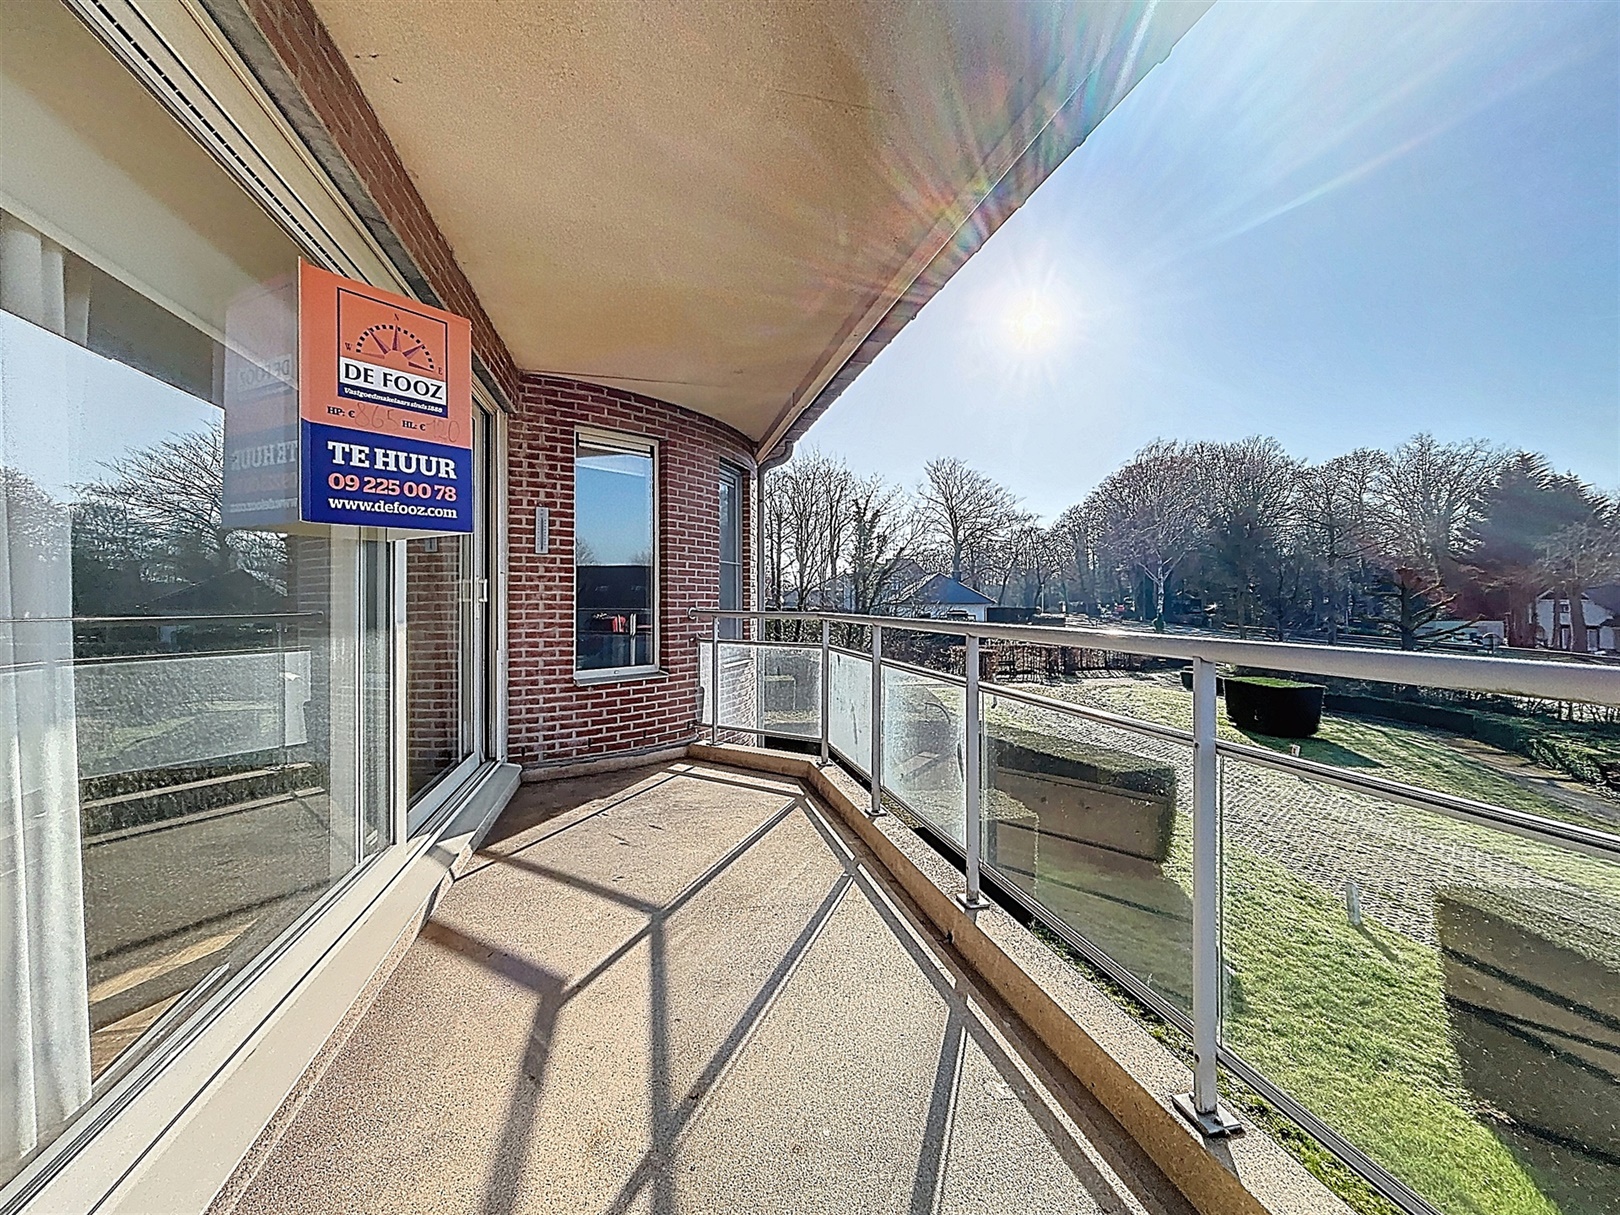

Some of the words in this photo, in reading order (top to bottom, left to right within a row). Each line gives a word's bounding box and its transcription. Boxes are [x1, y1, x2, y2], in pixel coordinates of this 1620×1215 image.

[344, 342, 353, 351] W
[344, 362, 375, 385] DE
[382, 371, 444, 400] FOOZ
[438, 366, 443, 376] E
[343, 387, 411, 407] Vastgoedmakelaars
[410, 401, 428, 411] sinds
[327, 405, 346, 417] HP:
[348, 409, 356, 419] €
[355, 402, 400, 431] 865
[401, 419, 418, 430] HL:
[419, 423, 427, 431] €
[327, 440, 370, 469] TE
[374, 448, 458, 480] HUUR
[328, 472, 360, 492] 09
[362, 476, 401, 496] 225
[403, 481, 432, 499] 00
[434, 484, 458, 502] 78
[328, 498, 459, 519] www.defooz.com
